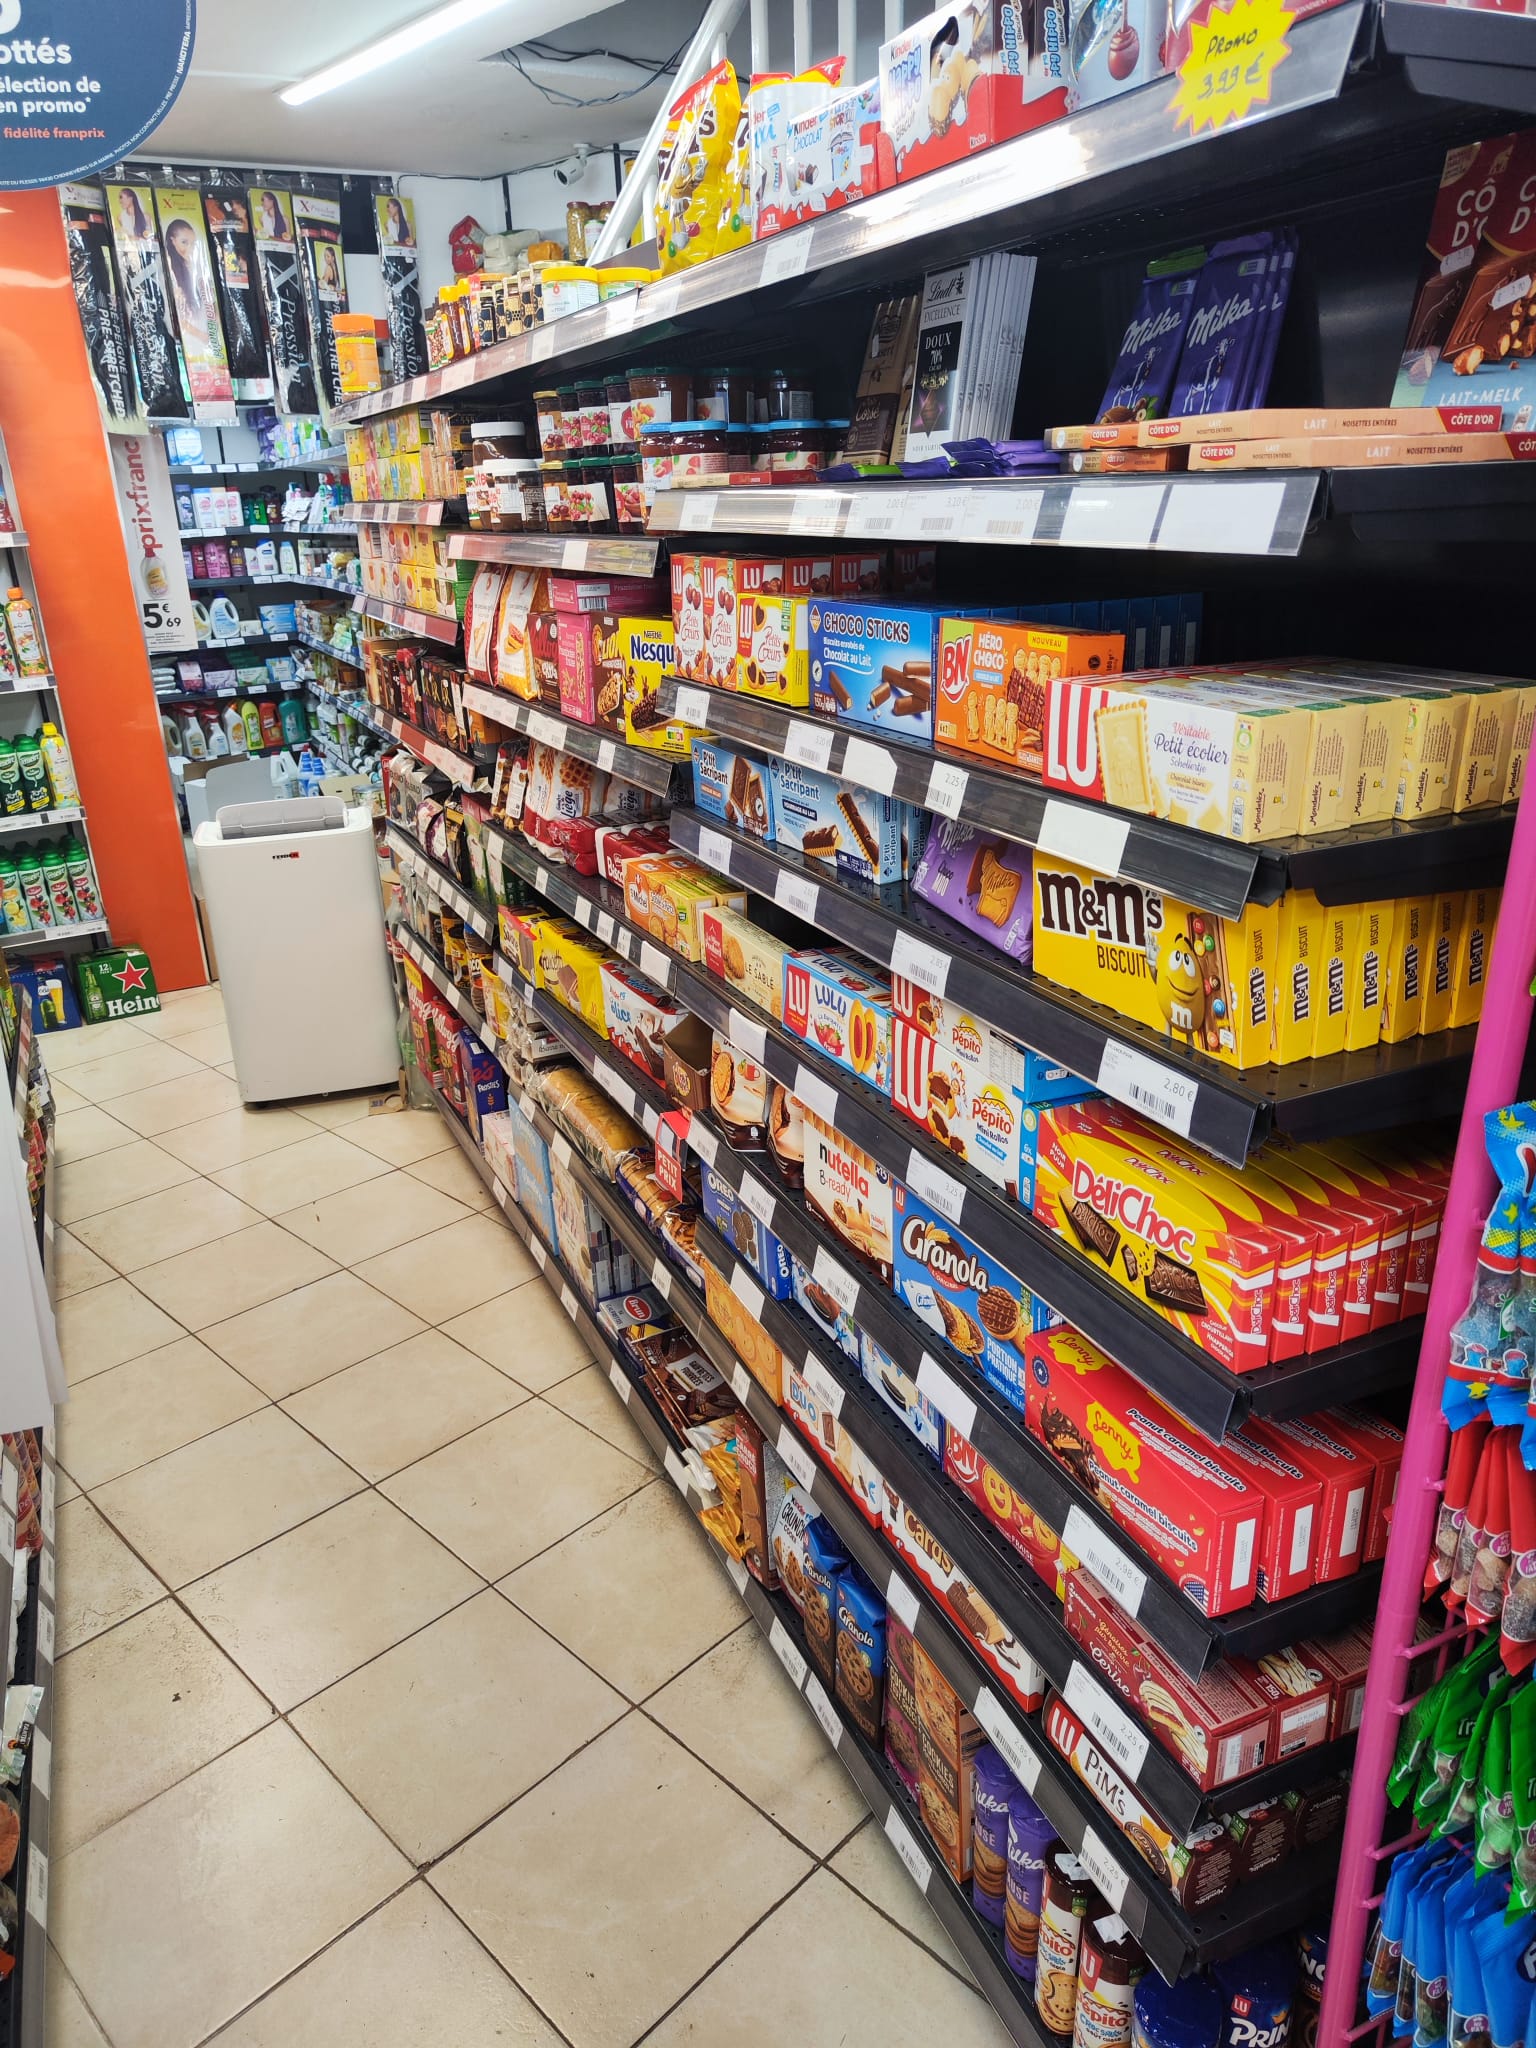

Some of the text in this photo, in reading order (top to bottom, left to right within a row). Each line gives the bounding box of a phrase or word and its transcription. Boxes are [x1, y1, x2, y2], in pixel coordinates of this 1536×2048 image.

[75, 75, 101, 94] de
[3, 126, 105, 141] fidélité franprix
[793, 128, 823, 153] CHOCOLAT
[927, 277, 957, 302] Lindt
[923, 304, 961, 323] EXCELLENCE
[1187, 298, 1253, 349] Milka
[925, 331, 952, 350] DOUX
[1119, 307, 1182, 356] Milka
[930, 349, 943, 366] 70%
[1149, 424, 1180, 435] CÔTE D'OR
[1303, 418, 1328, 430] LAIT
[1342, 419, 1372, 428] NOISETTES
[1450, 413, 1494, 425] CÔTE D'OR
[1092, 429, 1118, 440] CÔTE D'OR
[1201, 447, 1234, 459] CÔTE D'OR
[1366, 446, 1391, 457] LAIT
[1406, 446, 1437, 455] NOISETTES
[672, 564, 682, 595] LU
[703, 566, 714, 599] LU
[743, 567, 761, 590] LU
[793, 564, 809, 587] LU
[841, 561, 857, 584] LU
[143, 603, 181, 629] 5 € 69
[740, 604, 753, 639] LU
[823, 611, 910, 644] CHOCO STICKS
[643, 630, 663, 640] Nestlé
[978, 632, 1003, 651] HÉRO
[1031, 636, 1063, 648] NOUVEAU
[823, 647, 872, 667] Chocolat au Lait
[943, 636, 972, 690] BN
[973, 650, 1005, 670] CHOCO
[1047, 680, 1102, 787] LU
[1172, 721, 1212, 742] Véritable
[1154, 732, 1183, 756] Petit
[1187, 740, 1230, 766] écolier
[699, 763, 729, 786] Sacripant
[784, 763, 803, 782] P'tit
[780, 774, 820, 801] Sacripant
[889, 823, 897, 866] Sacripant
[1298, 925, 1308, 959] BISCUIT
[1335, 920, 1344, 953] BISCUIT
[1370, 914, 1379, 946] BISCUIT
[1254, 929, 1264, 962] BISCUIT
[811, 957, 843, 974] LULU
[1096, 944, 1148, 979] BISCUIT
[745, 964, 776, 991] LE SABLÉ
[788, 970, 807, 1017] LU
[814, 983, 847, 1019] LULU
[1170, 1000, 1193, 1030] m
[951, 1026, 982, 1056] Pépito
[894, 1018, 931, 1120] LU
[1162, 1075, 1195, 1103] 2,80 €
[972, 1098, 1013, 1135] Pépito
[657, 1149, 678, 1178] PETIT
[1049, 1150, 1066, 1170] PUUR
[1051, 1141, 1067, 1161] NOIR
[658, 1165, 677, 1193] PRIX
[819, 1141, 870, 1200] nutella
[707, 1170, 735, 1203] OREO
[819, 1169, 851, 1202] B-ready
[895, 1186, 904, 1207] LU
[777, 1243, 791, 1278] OREO
[902, 1216, 990, 1294] Granola
[628, 1298, 646, 1321] Brun
[1201, 1320, 1234, 1345] CROUSTILLANT
[987, 1336, 1018, 1374] PORTION
[1056, 1335, 1095, 1367] Lenny
[987, 1351, 1018, 1386] PRATIQUE
[1093, 1410, 1134, 1461] Lenny
[1313, 1428, 1357, 1462] biscuits
[1126, 1407, 1247, 1493] Peanut caramel biscuits
[1262, 1446, 1304, 1480] biscuits
[1088, 1460, 1198, 1553] Peanut caramel biscuits
[803, 1551, 833, 1591] Granola
[1115, 1557, 1134, 1579] 2,98
[837, 1605, 874, 1649] Granola
[1089, 1640, 1131, 1698] Cerise
[1052, 1707, 1077, 1758] LU
[1120, 1721, 1138, 1747] 2,25
[1102, 1856, 1121, 1881] 2,25
[1233, 1997, 1249, 2013] LU
